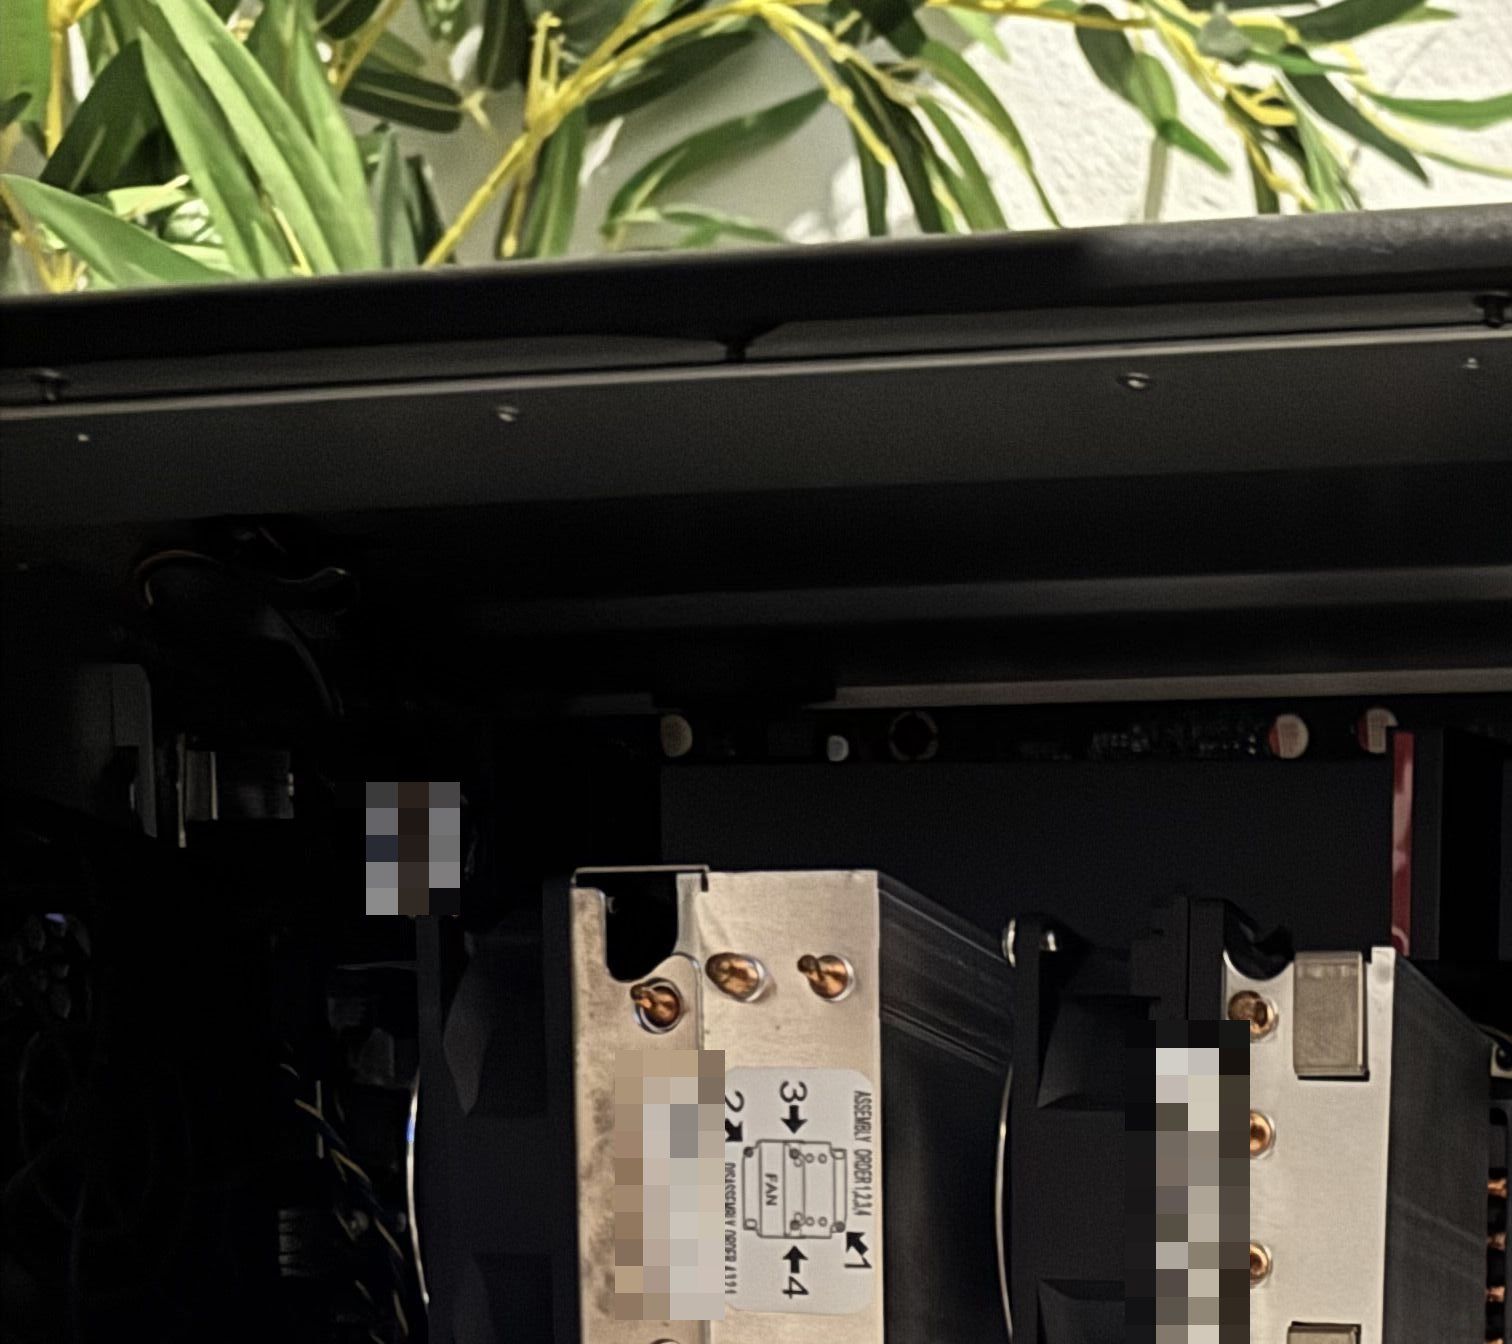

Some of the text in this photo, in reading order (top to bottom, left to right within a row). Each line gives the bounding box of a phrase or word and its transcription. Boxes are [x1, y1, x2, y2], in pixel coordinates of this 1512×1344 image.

[779, 1079, 808, 1104] 3
[853, 1090, 872, 1142] ASSEMBLY
[853, 1148, 872, 1184] ORDER
[765, 1172, 778, 1206] FAN
[844, 1256, 872, 1270] 1
[782, 1275, 809, 1300] 4
